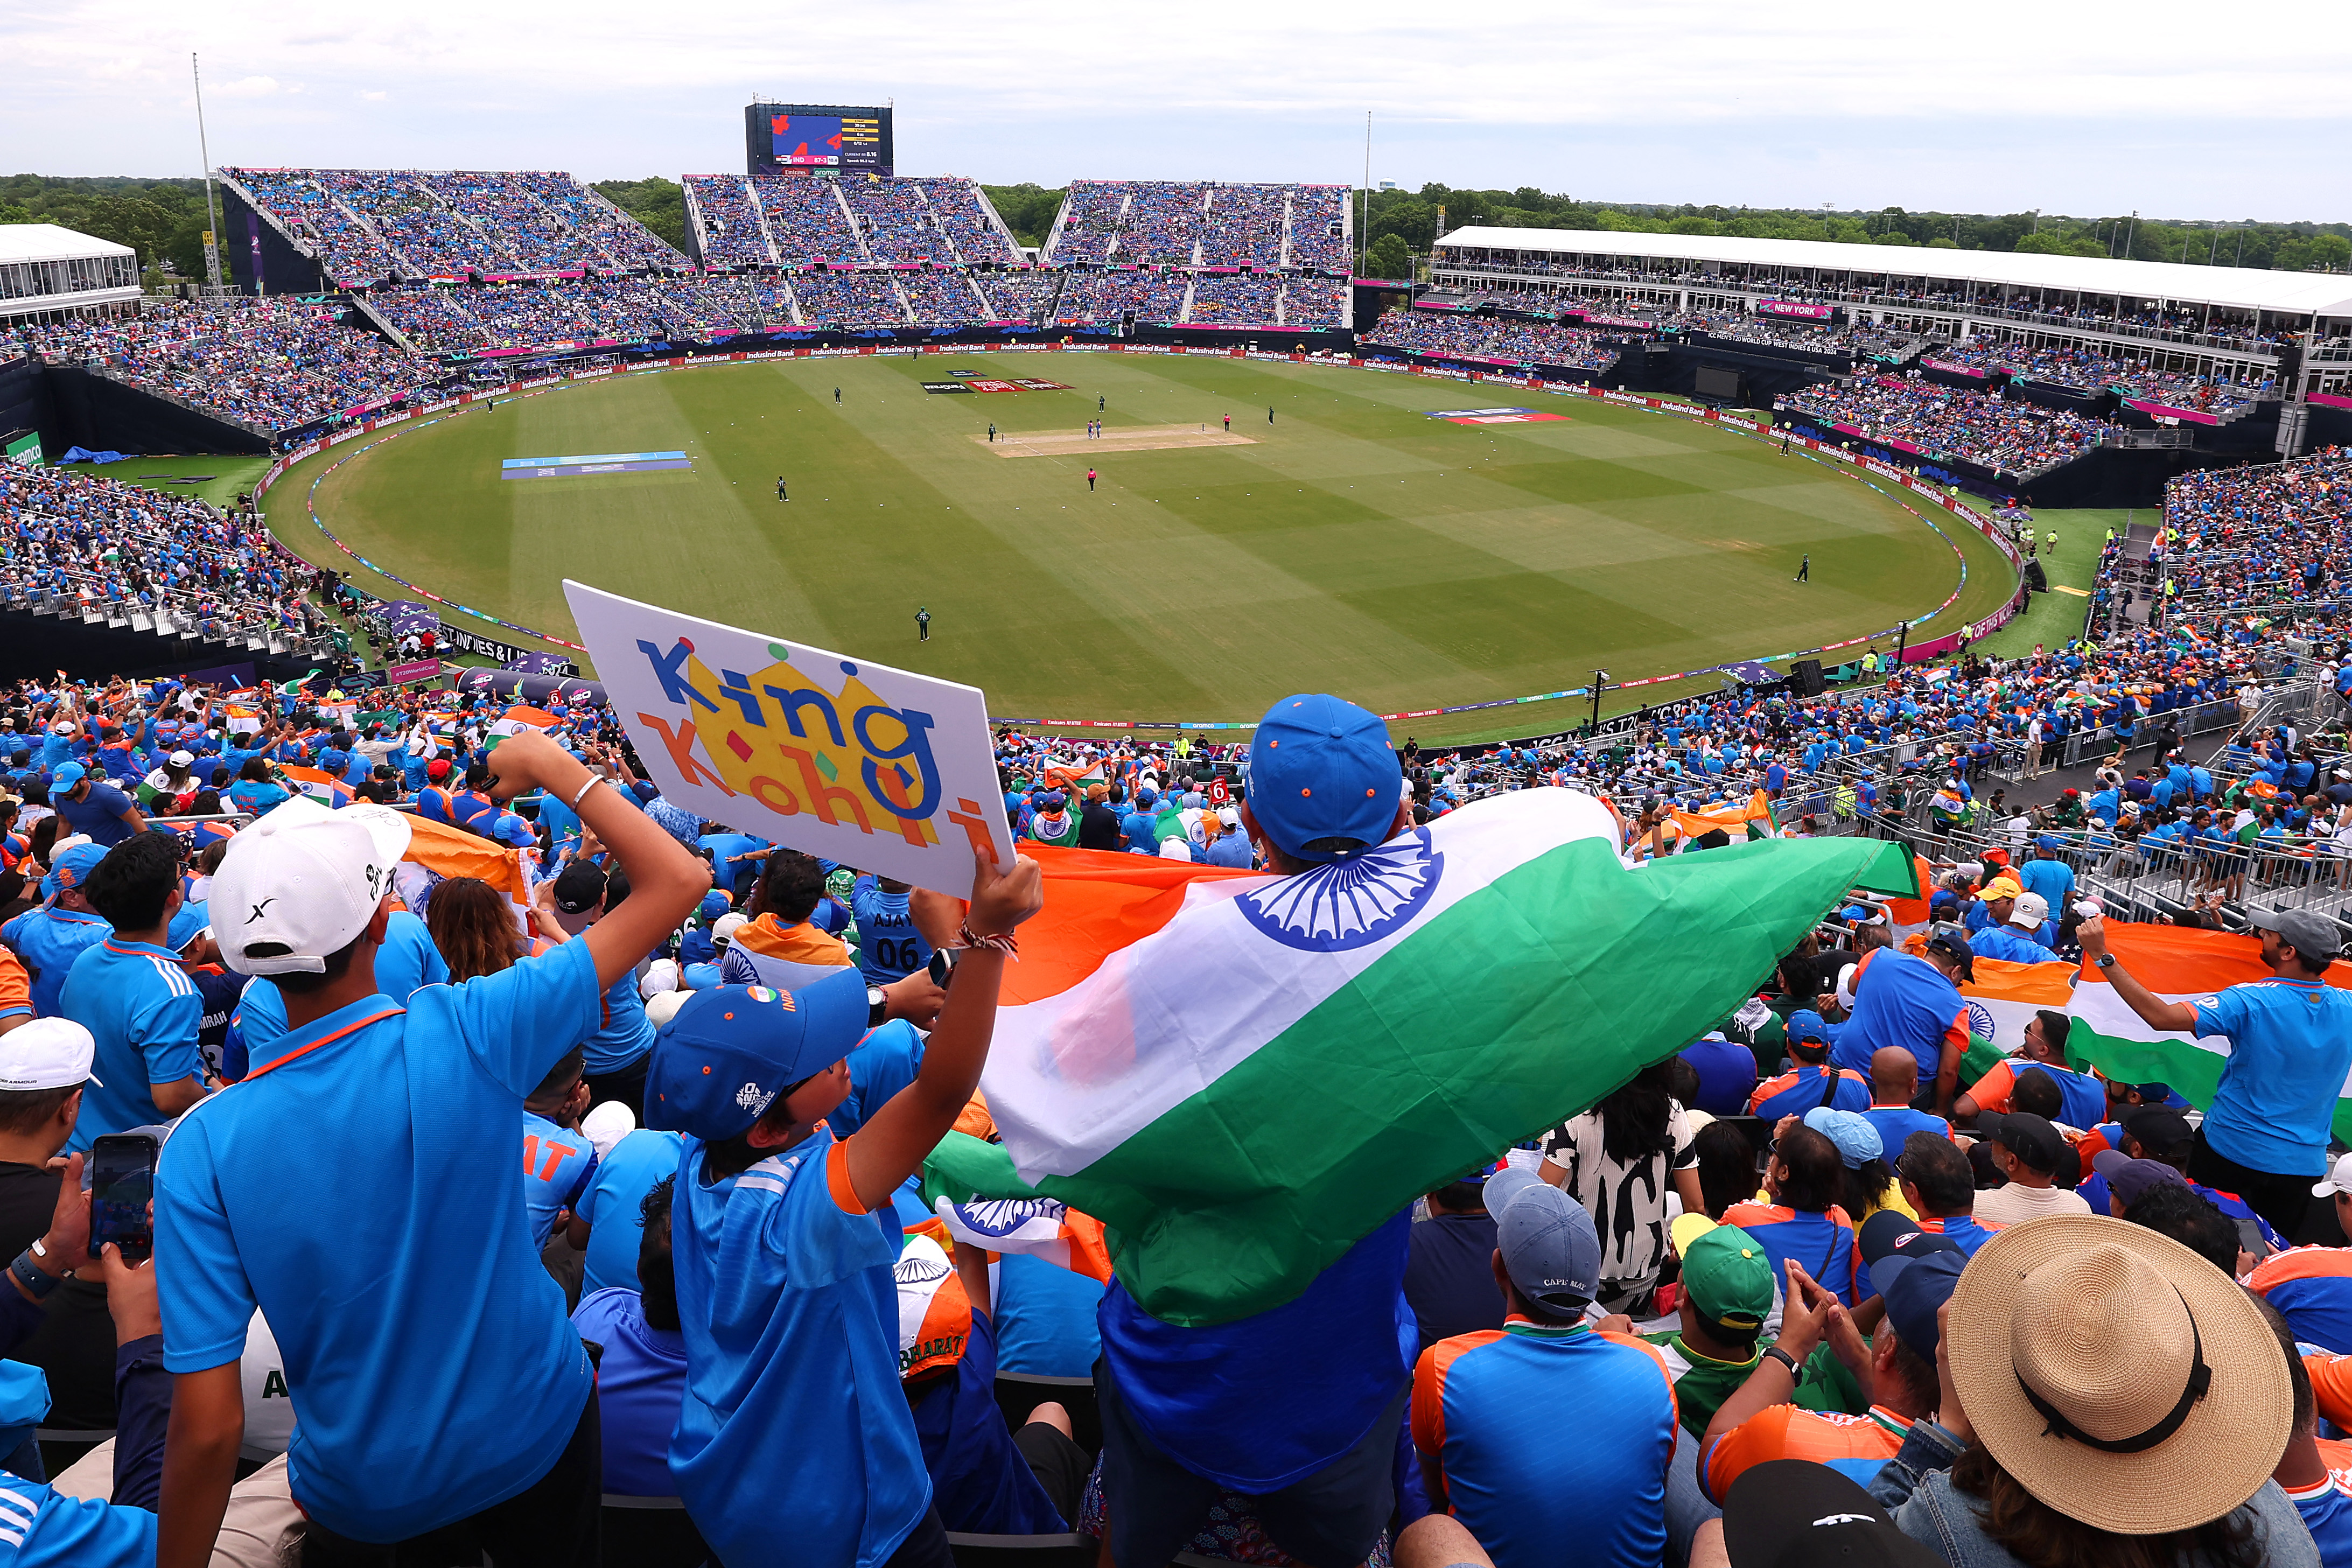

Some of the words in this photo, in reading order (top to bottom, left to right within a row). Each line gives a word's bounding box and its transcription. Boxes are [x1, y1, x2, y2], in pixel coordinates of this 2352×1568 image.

[1774, 303, 1793, 313] NEW
[1794, 305, 1816, 316] YORK
[1742, 336, 1761, 344] WORLD
[1789, 342, 1806, 351] INDIES
[1823, 347, 1837, 355] 2024
[684, 356, 713, 364] IndusInd
[747, 351, 776, 359] IndusInd
[1245, 351, 1274, 359] IndusInd
[1304, 355, 1333, 363] IndusInd
[626, 362, 653, 371] IndusInd
[1364, 360, 1392, 369] IndusInd
[1393, 363, 1409, 371] Bank
[1423, 367, 1451, 376] IndusInd
[1931, 362, 1969, 374] #T20WORLDCUP
[573, 369, 598, 380] IndusInd
[598, 367, 613, 375] Bank
[1482, 374, 1511, 383] IndusInd
[1511, 377, 1528, 386] Bank
[522, 379, 547, 389] IndusInd
[547, 375, 560, 384] Bank
[1543, 381, 1572, 391] IndusInd
[1572, 386, 1589, 394] Bank
[472, 389, 495, 401] IndusInd
[496, 386, 510, 395] Bank
[1604, 390, 1632, 402] IndusInd
[1632, 396, 1647, 405] Bank
[423, 401, 446, 414] IndusInd
[446, 398, 460, 408] Bank
[1661, 401, 1690, 413] IndusInd
[1690, 407, 1705, 417] Bank
[375, 414, 398, 429] IndusInd
[398, 410, 411, 422] Bank
[1718, 413, 1743, 426] IndusInd
[1743, 421, 1758, 431] Bank
[330, 429, 351, 446] IndusInd
[351, 424, 364, 436] Bank
[1791, 435, 1807, 446] Bank
[290, 446, 307, 465] IndusInd
[1818, 443, 1842, 458] IndusInd
[1842, 451, 1856, 463] Bank
[1866, 460, 1889, 477] IndusInd
[1888, 470, 1902, 482] Bank
[1911, 480, 1932, 499] IndusInd
[1931, 491, 1944, 505] Bank
[1958, 627, 1975, 646] OT
[1975, 621, 1986, 638] OF
[496, 645, 506, 662] &
[1886, 655, 1895, 671] 4
[396, 665, 435, 677] #T20WorldCup
[551, 693, 559, 704] 6
[636, 639, 941, 820] King
[2082, 735, 2095, 744] 147
[636, 712, 999, 864] Kohli
[1213, 782, 1224, 799] 6
[236, 794, 257, 804] VIRAT
[873, 913, 912, 927] AJAY
[877, 937, 919, 971] 06
[778, 989, 796, 1012] INDIA
[199, 1010, 227, 1031] MRAH
[752, 1100, 766, 1115] WORLD
[1543, 1278, 1567, 1286] CAPE
[1569, 1280, 1586, 1291] MAY
[899, 1336, 964, 1372] BHARAT
[262, 1370, 289, 1398] A
